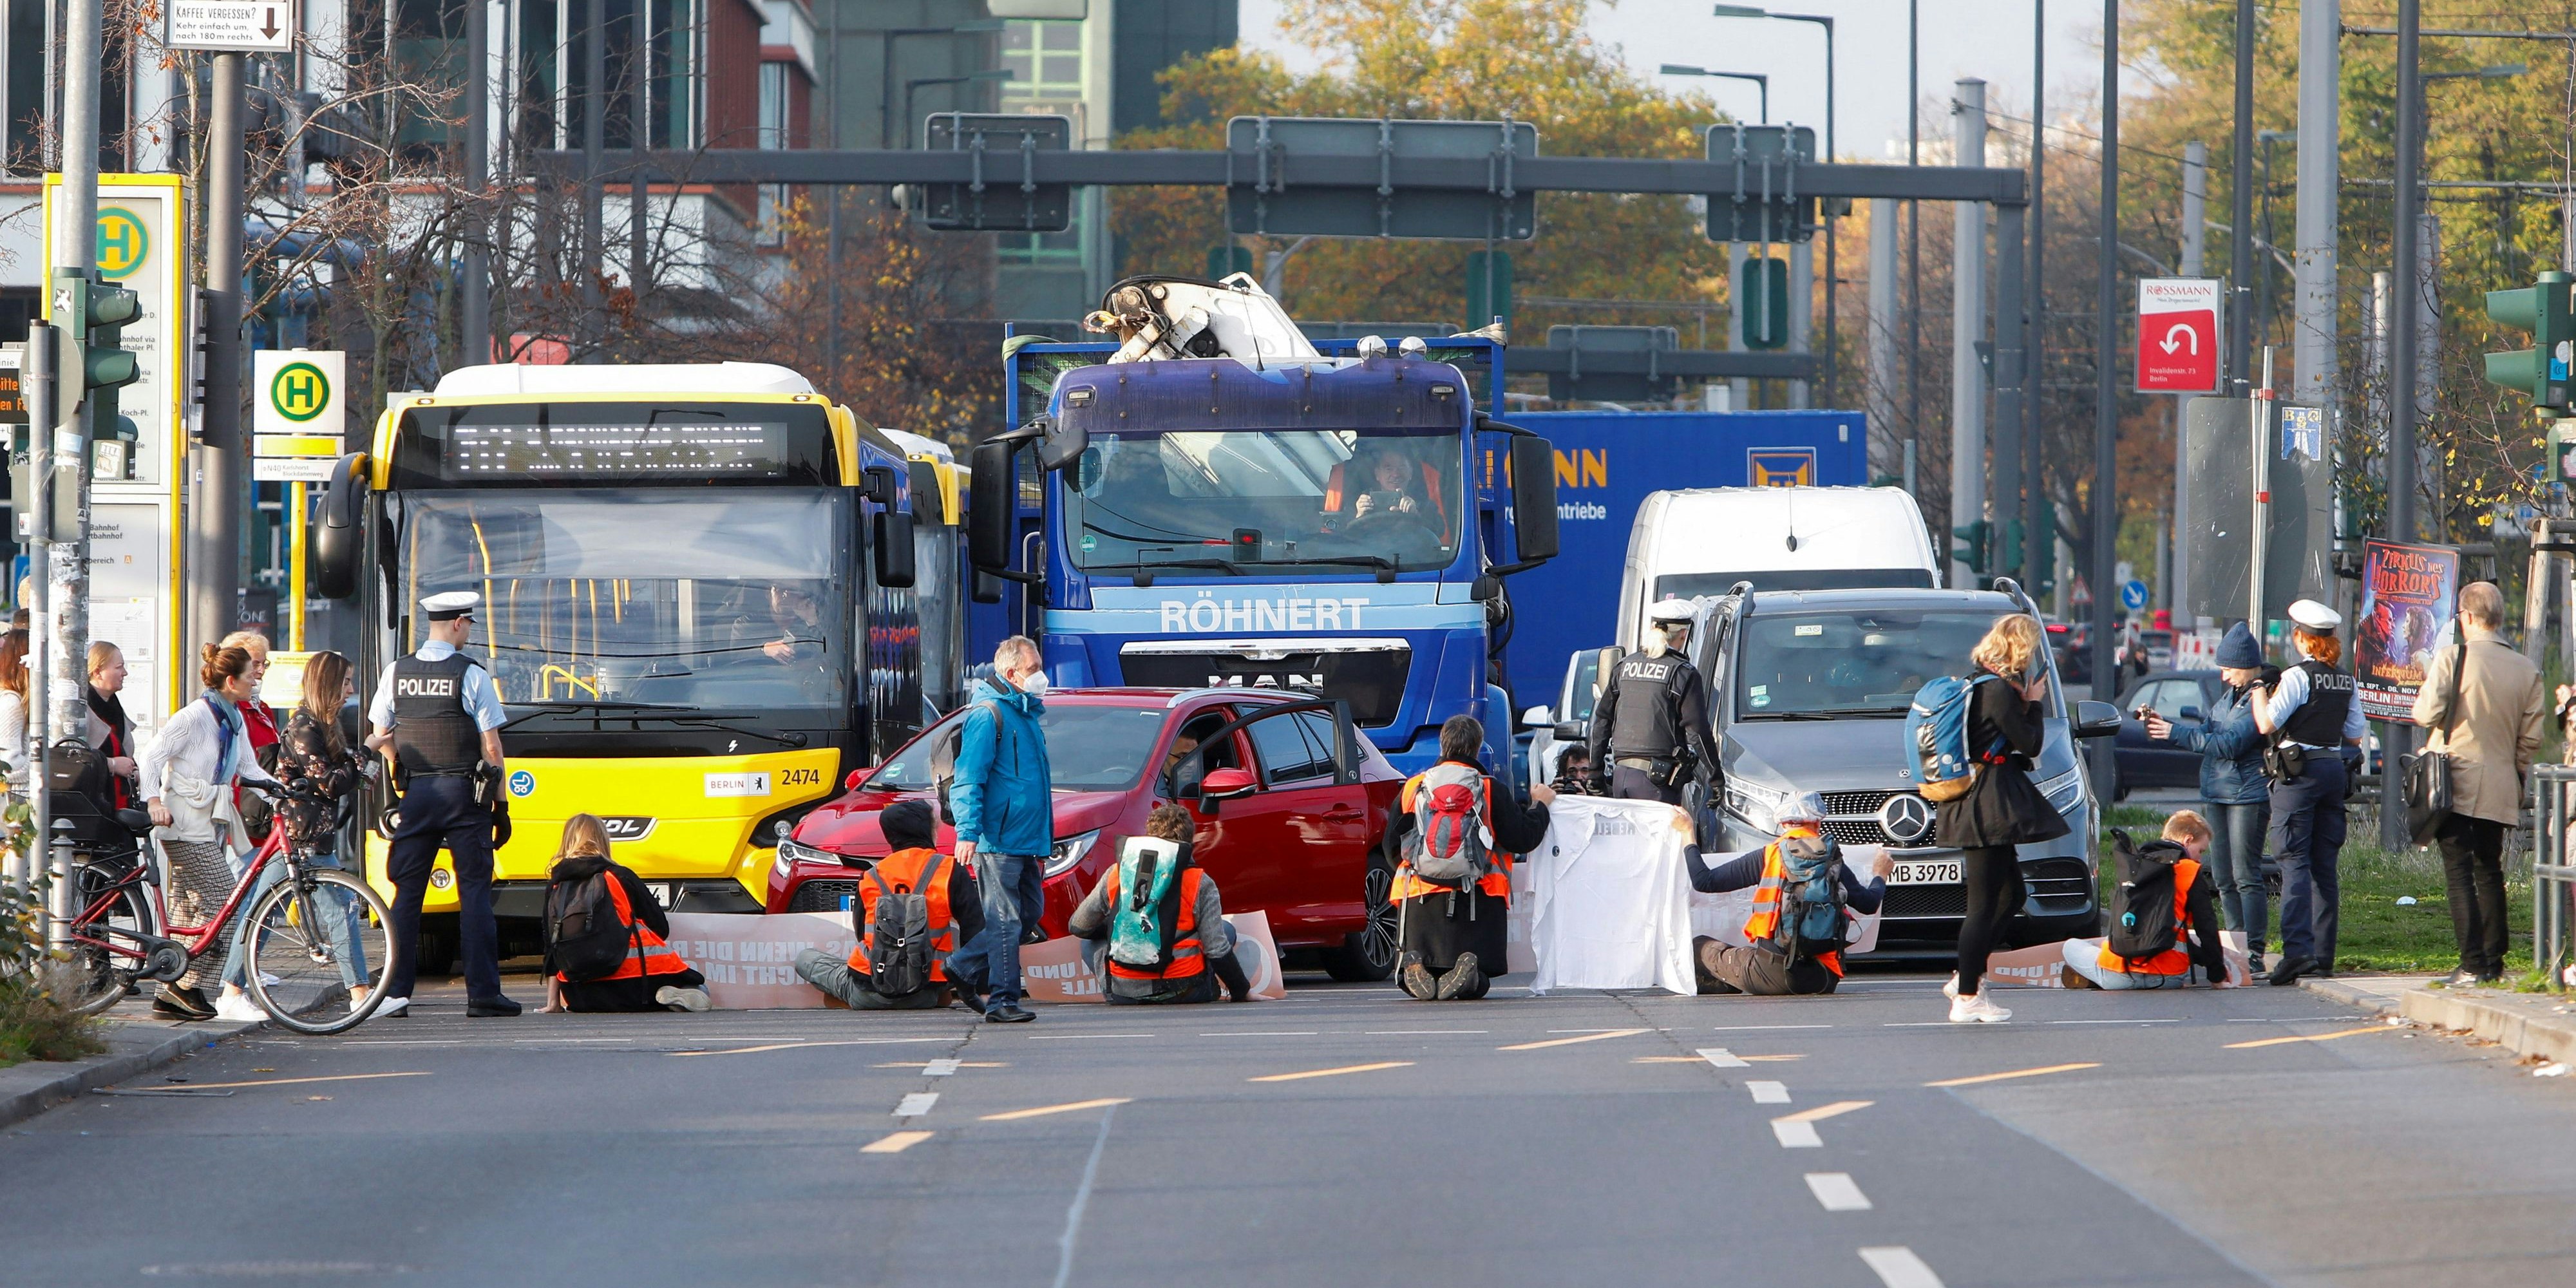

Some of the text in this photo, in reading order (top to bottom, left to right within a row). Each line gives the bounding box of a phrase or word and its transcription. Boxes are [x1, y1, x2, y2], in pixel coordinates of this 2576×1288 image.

[286, 376, 314, 408] H
[1160, 591, 1369, 633] RÖHNERT
[1622, 662, 1669, 680] POLIZEI
[397, 678, 453, 696] POLIZEI
[2315, 674, 2353, 691] POLIZEI
[2358, 690, 2391, 704] BERLIN
[710, 780, 744, 789] BERLIN
[781, 769, 820, 785] 2474
[1915, 864, 1958, 882] 3978
